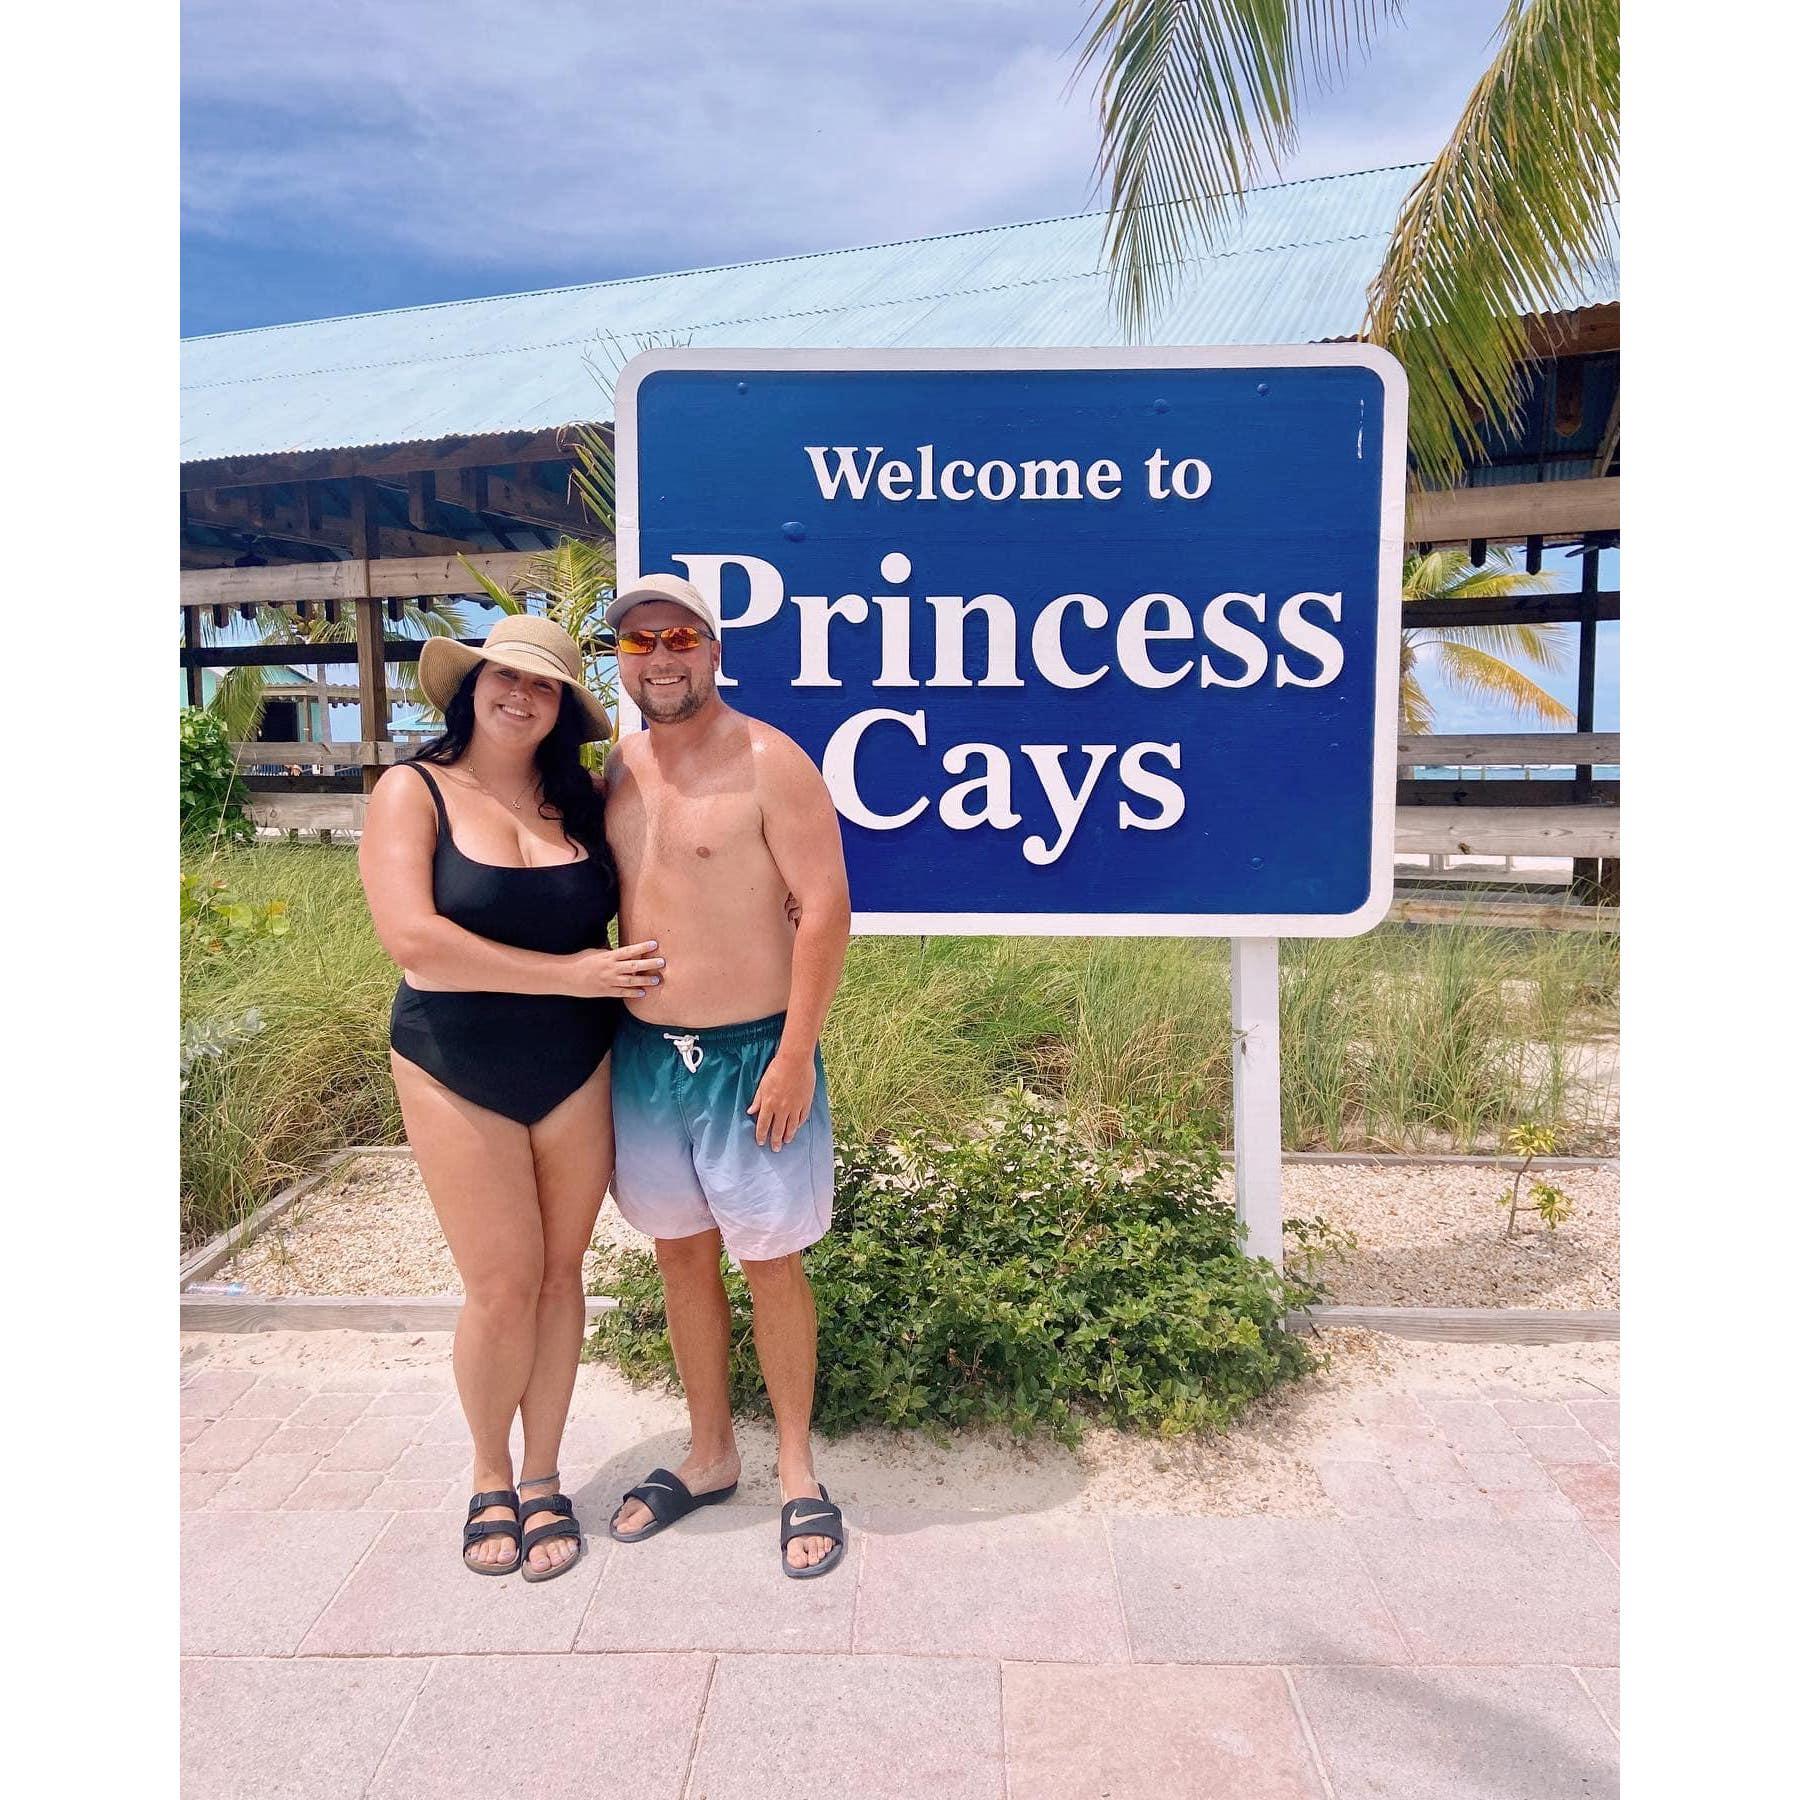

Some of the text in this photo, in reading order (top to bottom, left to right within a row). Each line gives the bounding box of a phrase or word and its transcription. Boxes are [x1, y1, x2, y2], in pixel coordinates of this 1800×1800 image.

[803, 445, 1212, 501] Welcome to
[671, 552, 1345, 689] Princess
[822, 708, 1186, 867] Cays
